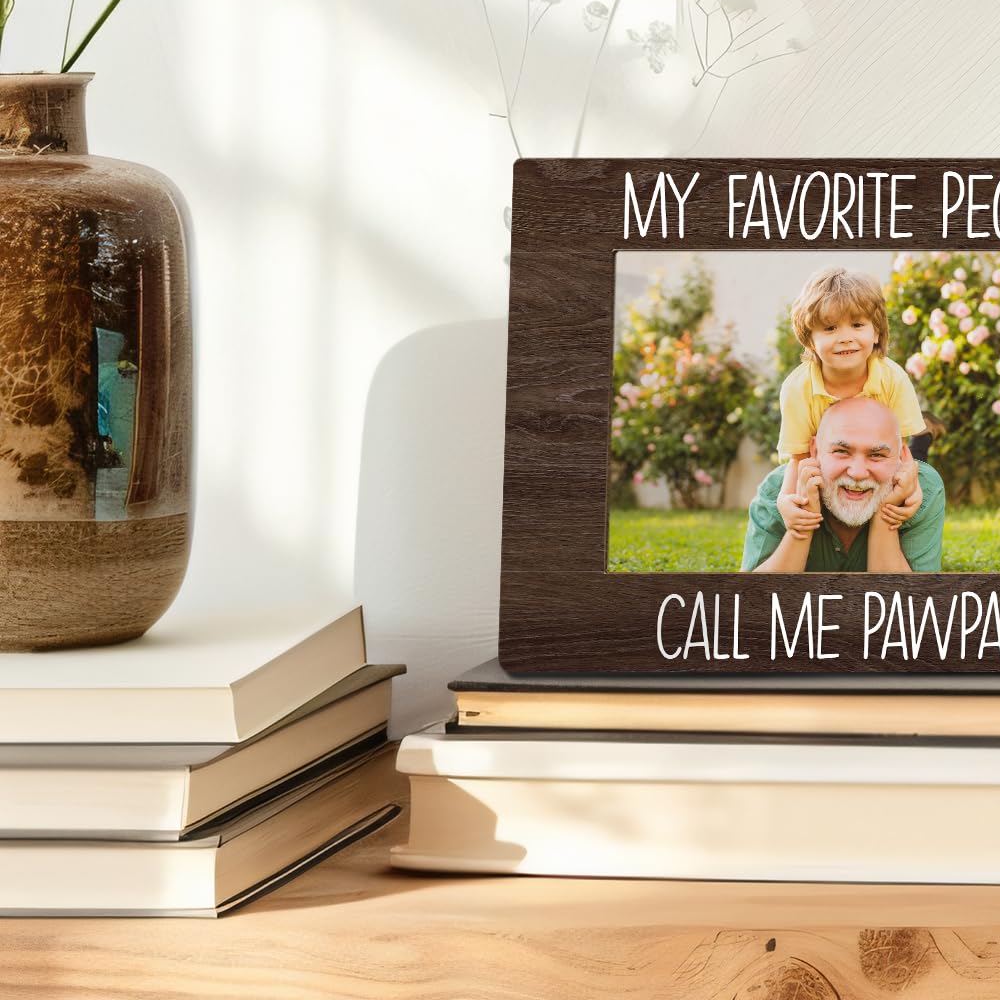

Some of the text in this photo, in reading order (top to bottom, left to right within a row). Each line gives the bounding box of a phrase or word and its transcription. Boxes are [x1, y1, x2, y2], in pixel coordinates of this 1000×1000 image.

[623, 171, 700, 240] MY
[728, 170, 917, 241] FAVORITE
[656, 590, 750, 661] CALL
[770, 591, 844, 661] ME
